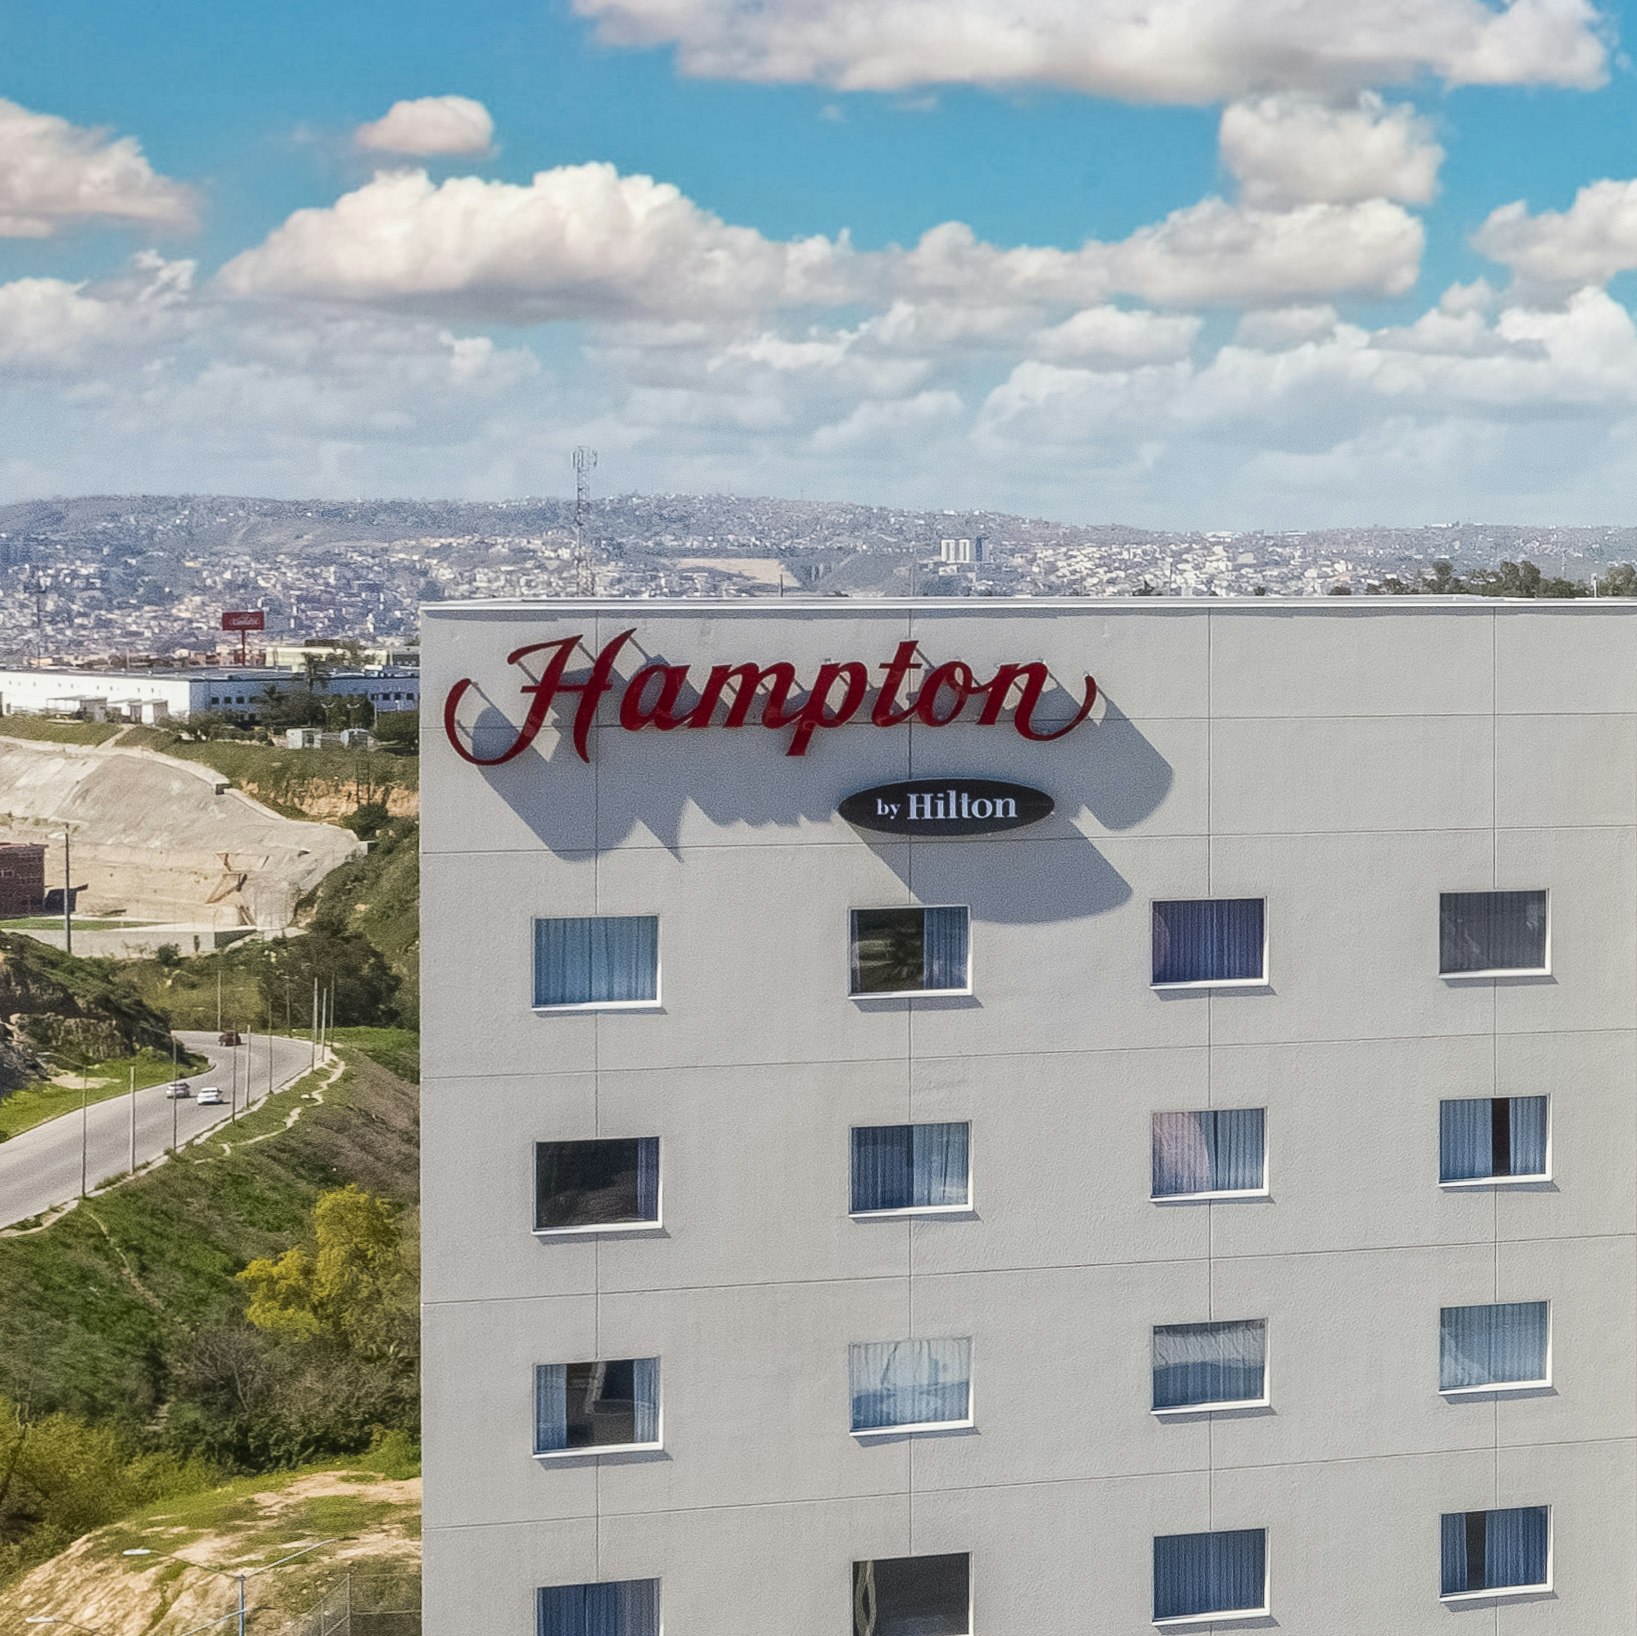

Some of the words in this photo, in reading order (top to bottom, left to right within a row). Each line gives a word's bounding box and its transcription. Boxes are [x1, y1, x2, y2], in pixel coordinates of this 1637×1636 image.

[442, 627, 1097, 766] Hampton
[876, 797, 901, 820] by
[906, 791, 1018, 821] Hilton
